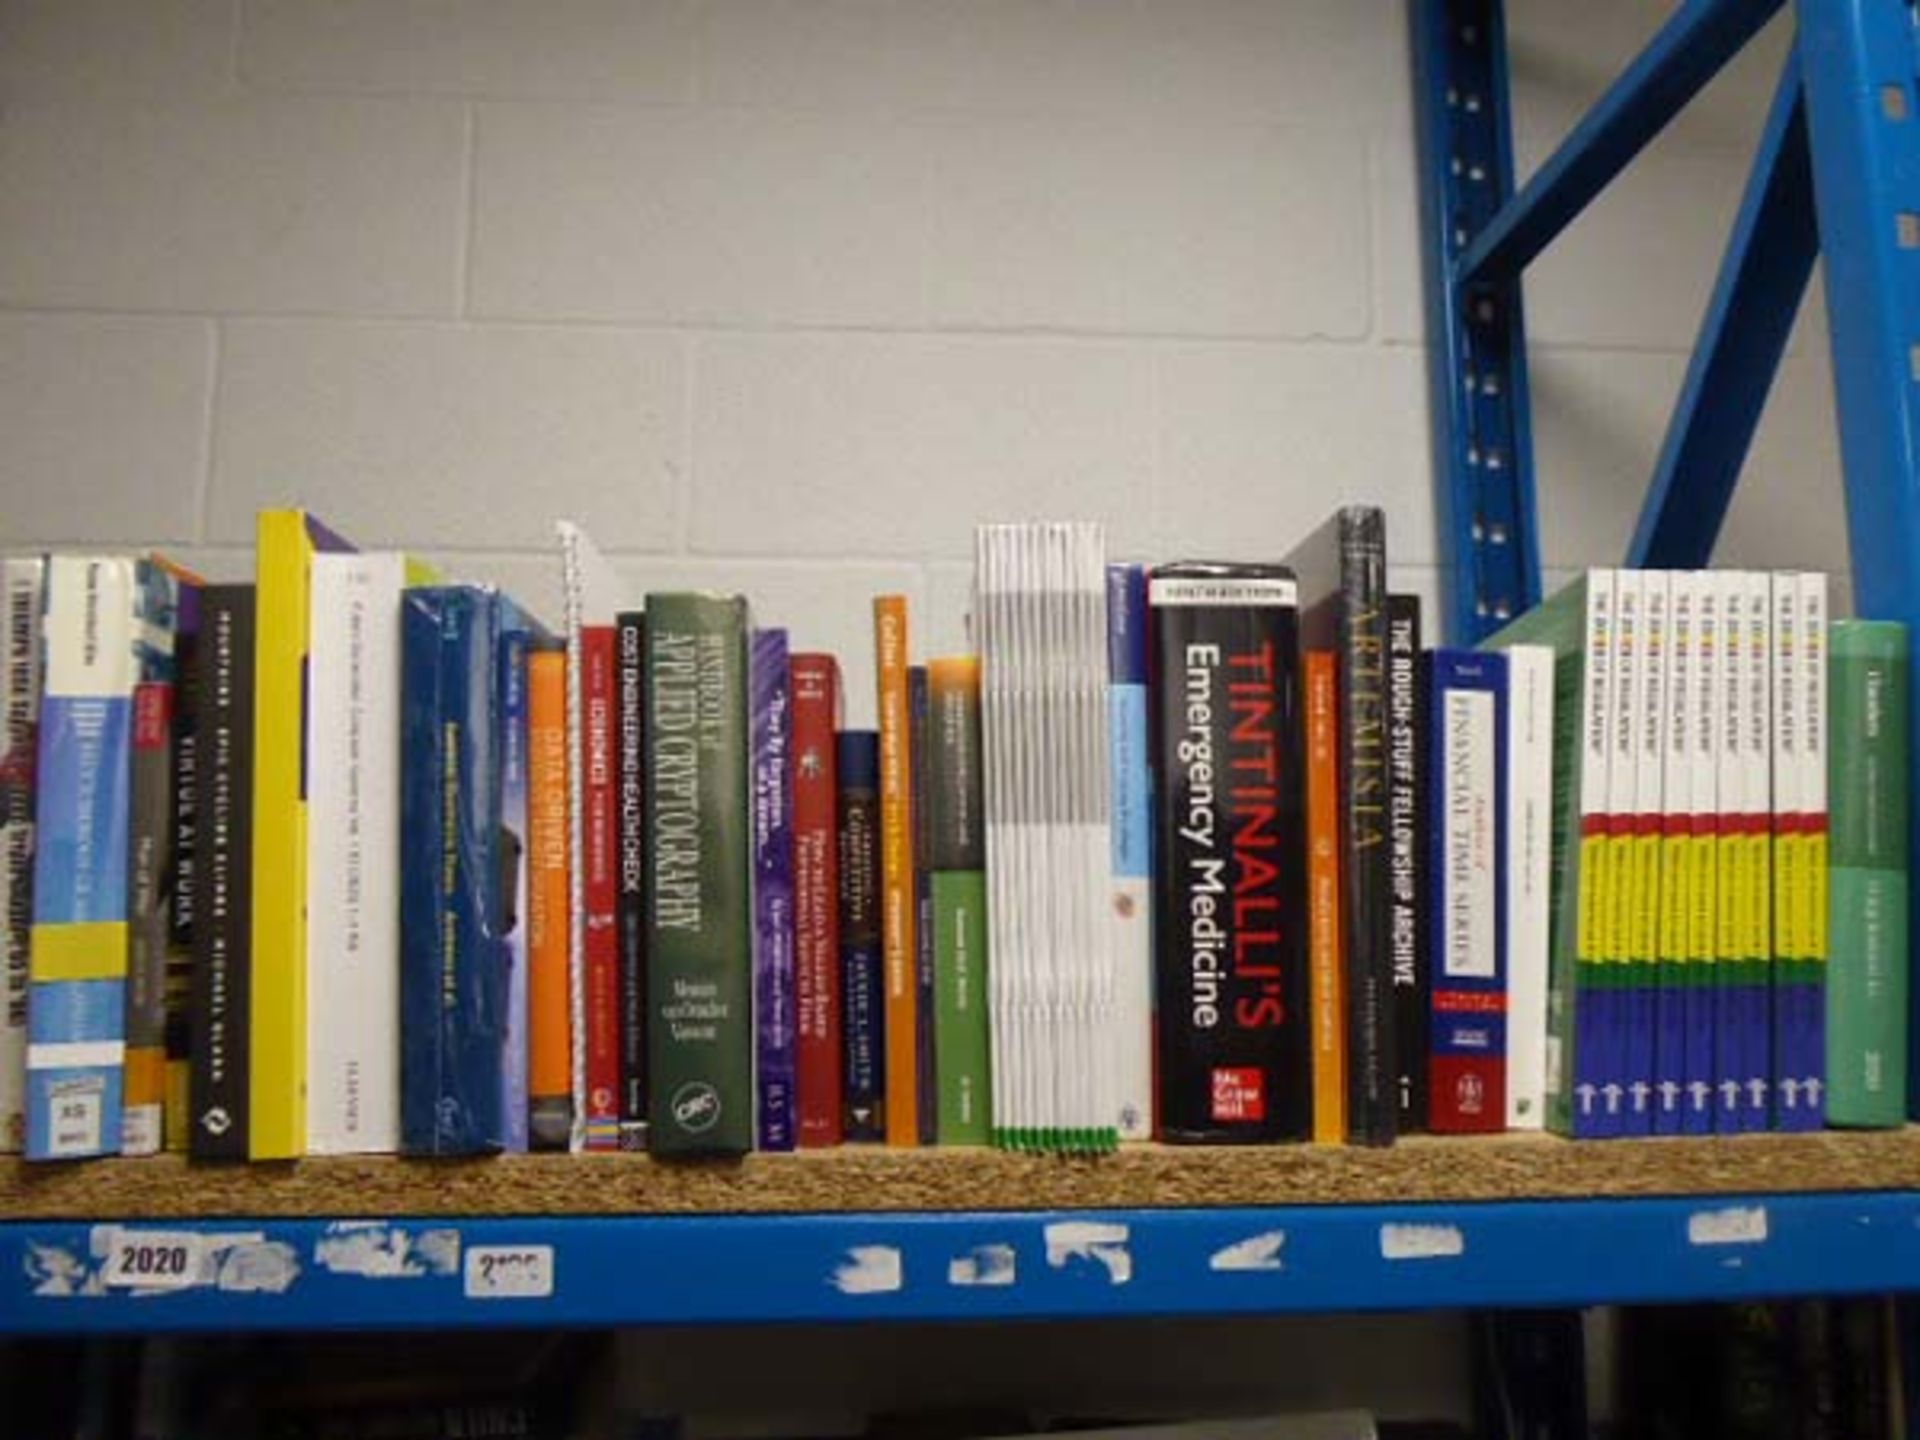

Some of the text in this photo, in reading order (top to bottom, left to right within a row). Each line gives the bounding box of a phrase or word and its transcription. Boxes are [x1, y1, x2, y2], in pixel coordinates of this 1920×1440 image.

[622, 626, 639, 664] COST
[653, 630, 701, 932] APPLIED CRYPTOGRAPHY
[1352, 608, 1383, 853] ARTEMISIA
[1453, 696, 1473, 818] FINANCIAL
[1180, 641, 1227, 1026] Emergency Medicine
[1227, 638, 1282, 1027] TINTINALLI'S
[1391, 618, 1416, 985] THE ROUGH-STUFF FELLOWSHIP ARCHIVE
[119, 1246, 187, 1275] 2020
